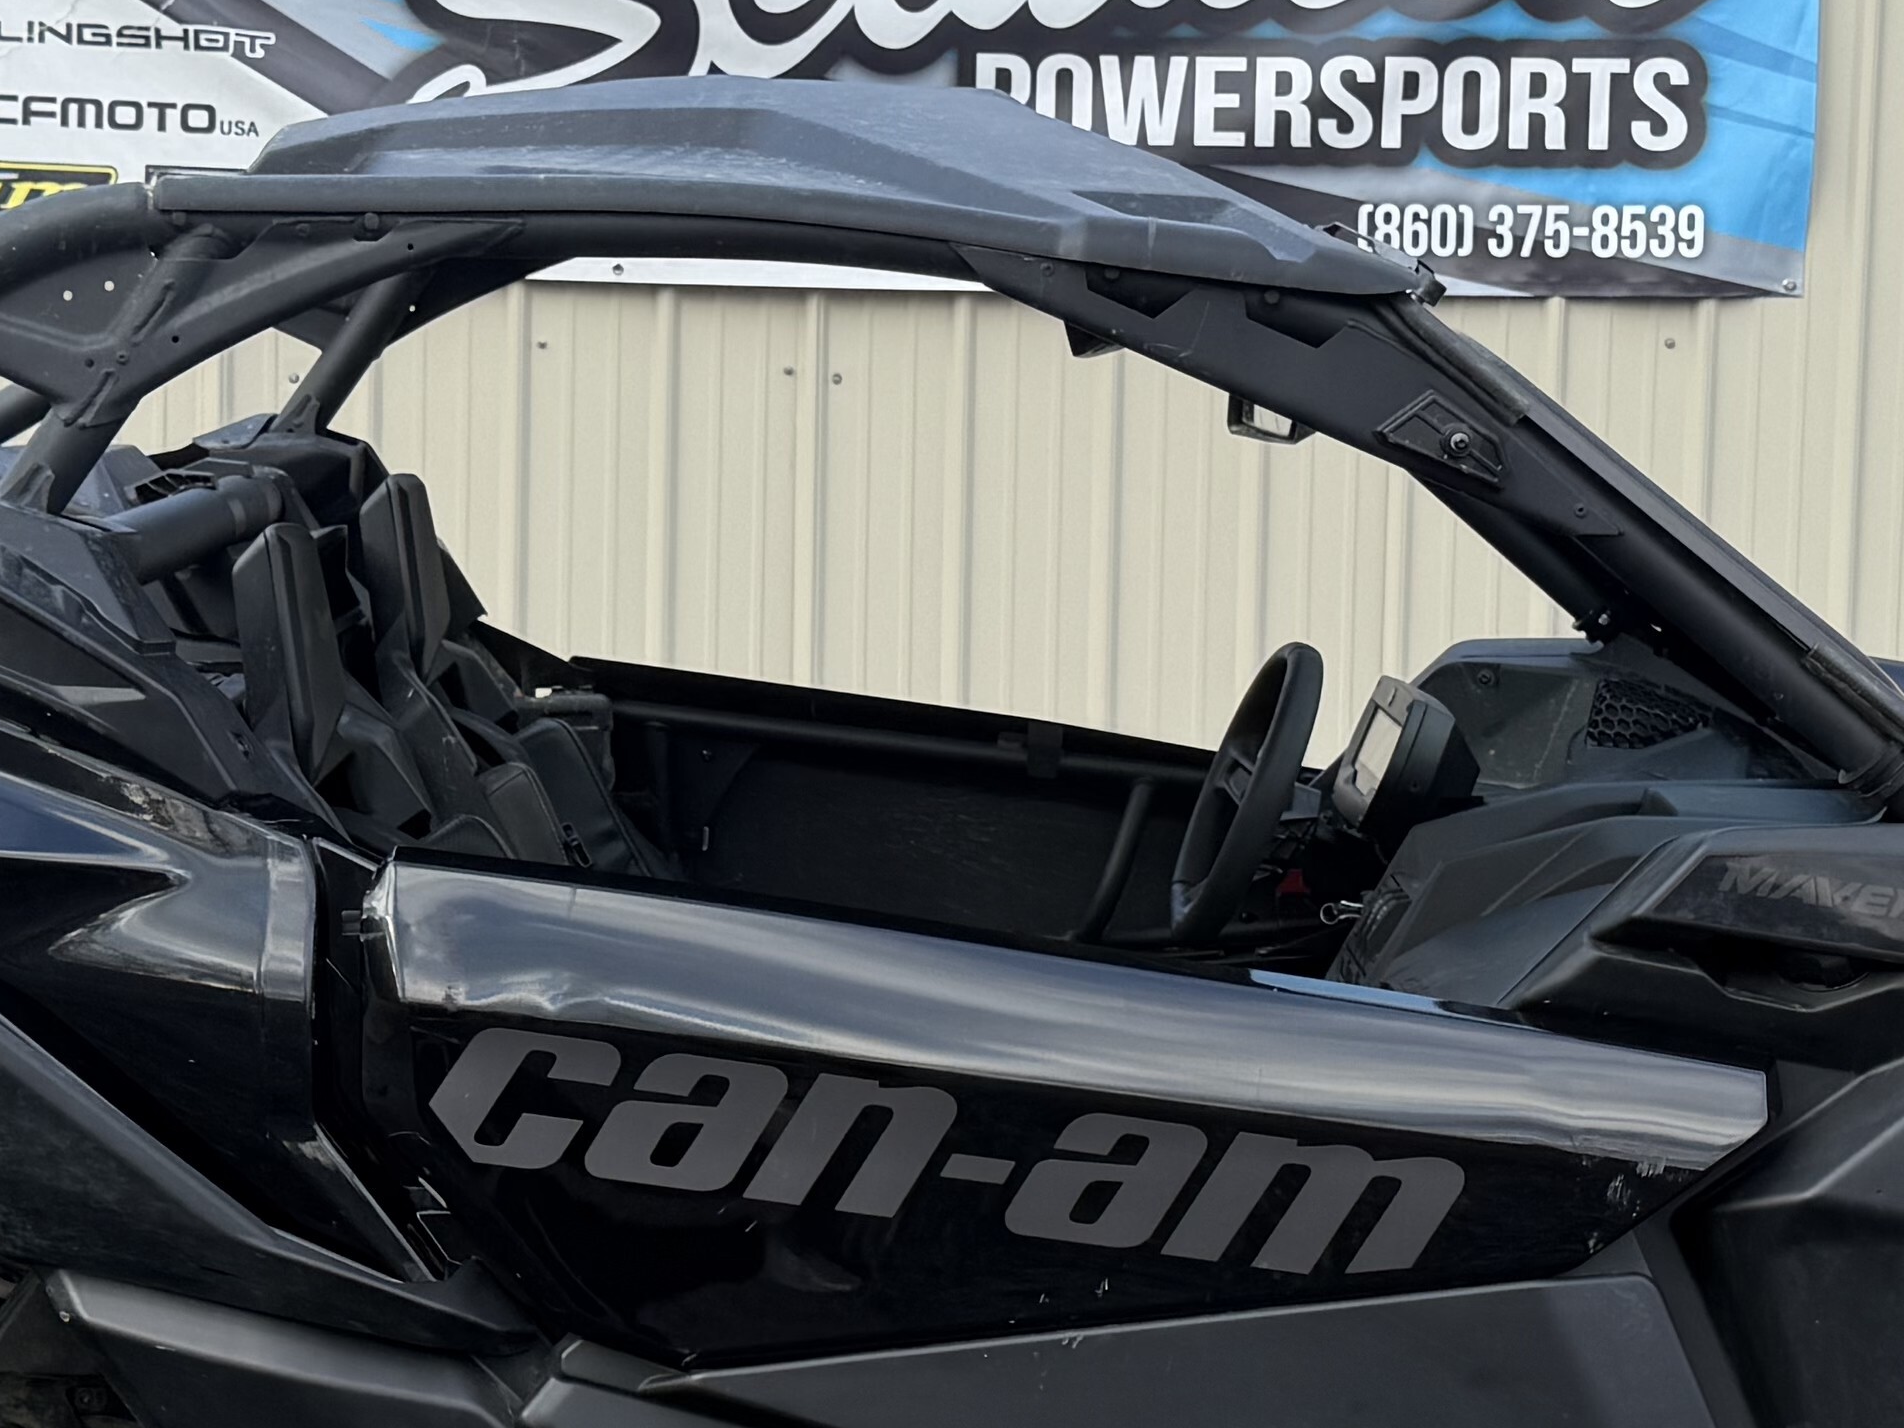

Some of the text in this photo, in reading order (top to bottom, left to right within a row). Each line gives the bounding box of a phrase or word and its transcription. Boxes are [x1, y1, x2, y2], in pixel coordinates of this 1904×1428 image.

[219, 119, 260, 138] USA
[975, 52, 1690, 151] POWERSPORTS
[1357, 203, 1706, 258] (860) 375-8539
[427, 1027, 1466, 1275] can-am
